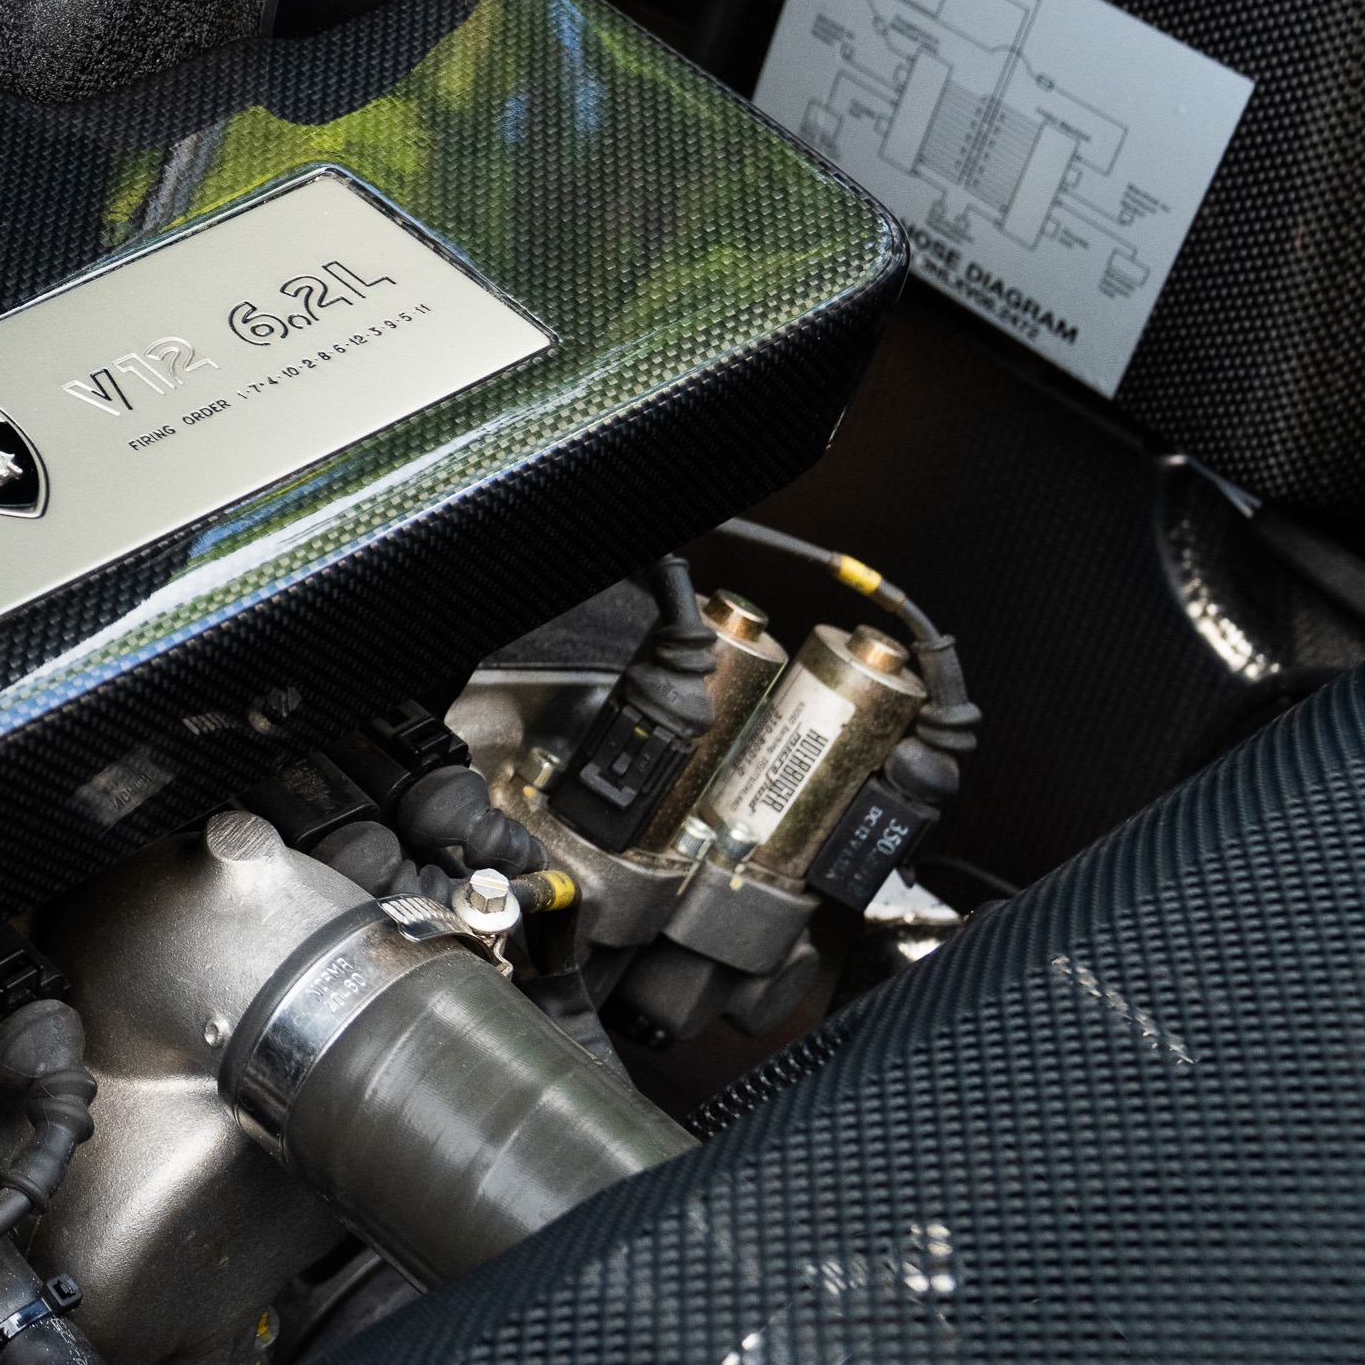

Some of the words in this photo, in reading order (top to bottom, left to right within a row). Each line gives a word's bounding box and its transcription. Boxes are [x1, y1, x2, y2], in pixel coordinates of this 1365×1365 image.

[62, 335, 221, 416] V12
[227, 260, 397, 346] 6.2L
[966, 262, 1079, 345] DIAGRAM
[130, 421, 178, 452] FIRING
[182, 398, 234, 430] ORDER
[760, 729, 827, 812] HOERBIGER
[306, 957, 354, 1002] NORMA
